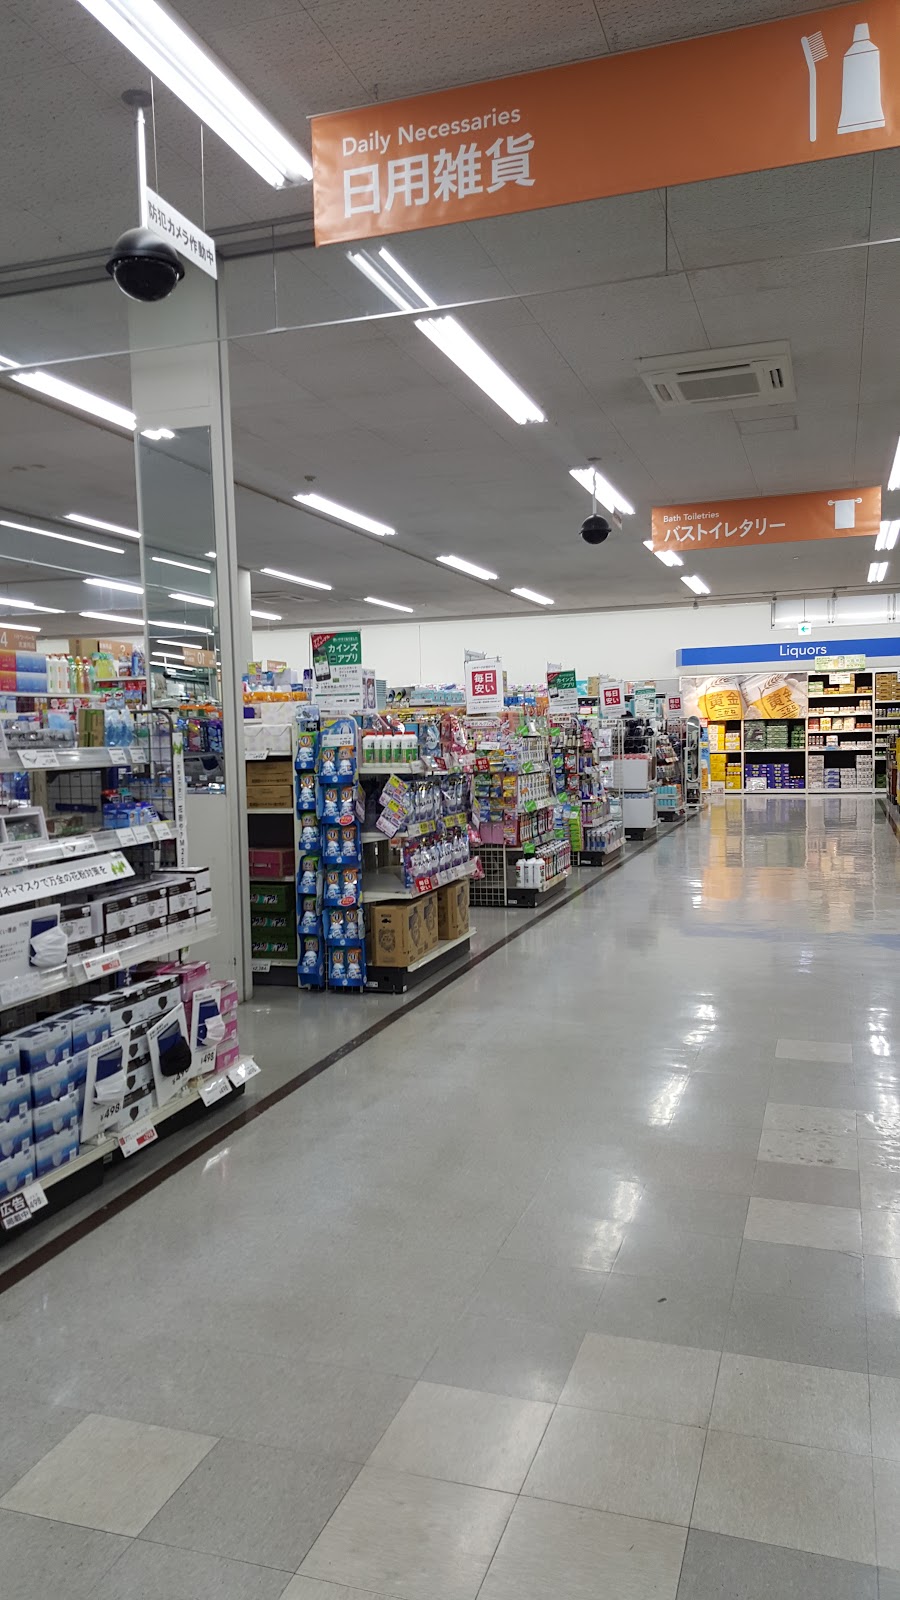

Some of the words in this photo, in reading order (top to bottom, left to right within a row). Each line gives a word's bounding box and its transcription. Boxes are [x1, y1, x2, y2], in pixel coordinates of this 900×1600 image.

[342, 131, 391, 157] Daily
[398, 108, 521, 145] Necessaries
[343, 132, 535, 219] 日用雑貨
[147, 200, 214, 265] 防犯カメラ作動中
[663, 515, 682, 523] Bath
[683, 511, 720, 521] Toiletries
[663, 518, 786, 542] バストイレタリー
[328, 643, 359, 653] カインズ
[779, 645, 827, 658] Liquors
[337, 653, 358, 663] アプリ
[474, 672, 494, 683] 毎日
[474, 683, 495, 694] 安い
[709, 691, 740, 710] 黄金
[0, 865, 108, 898] ネ+マスクで万全の花粉対策を
[100, 1103, 120, 1122] ¥498
[0, 1196, 26, 1218] 広告
